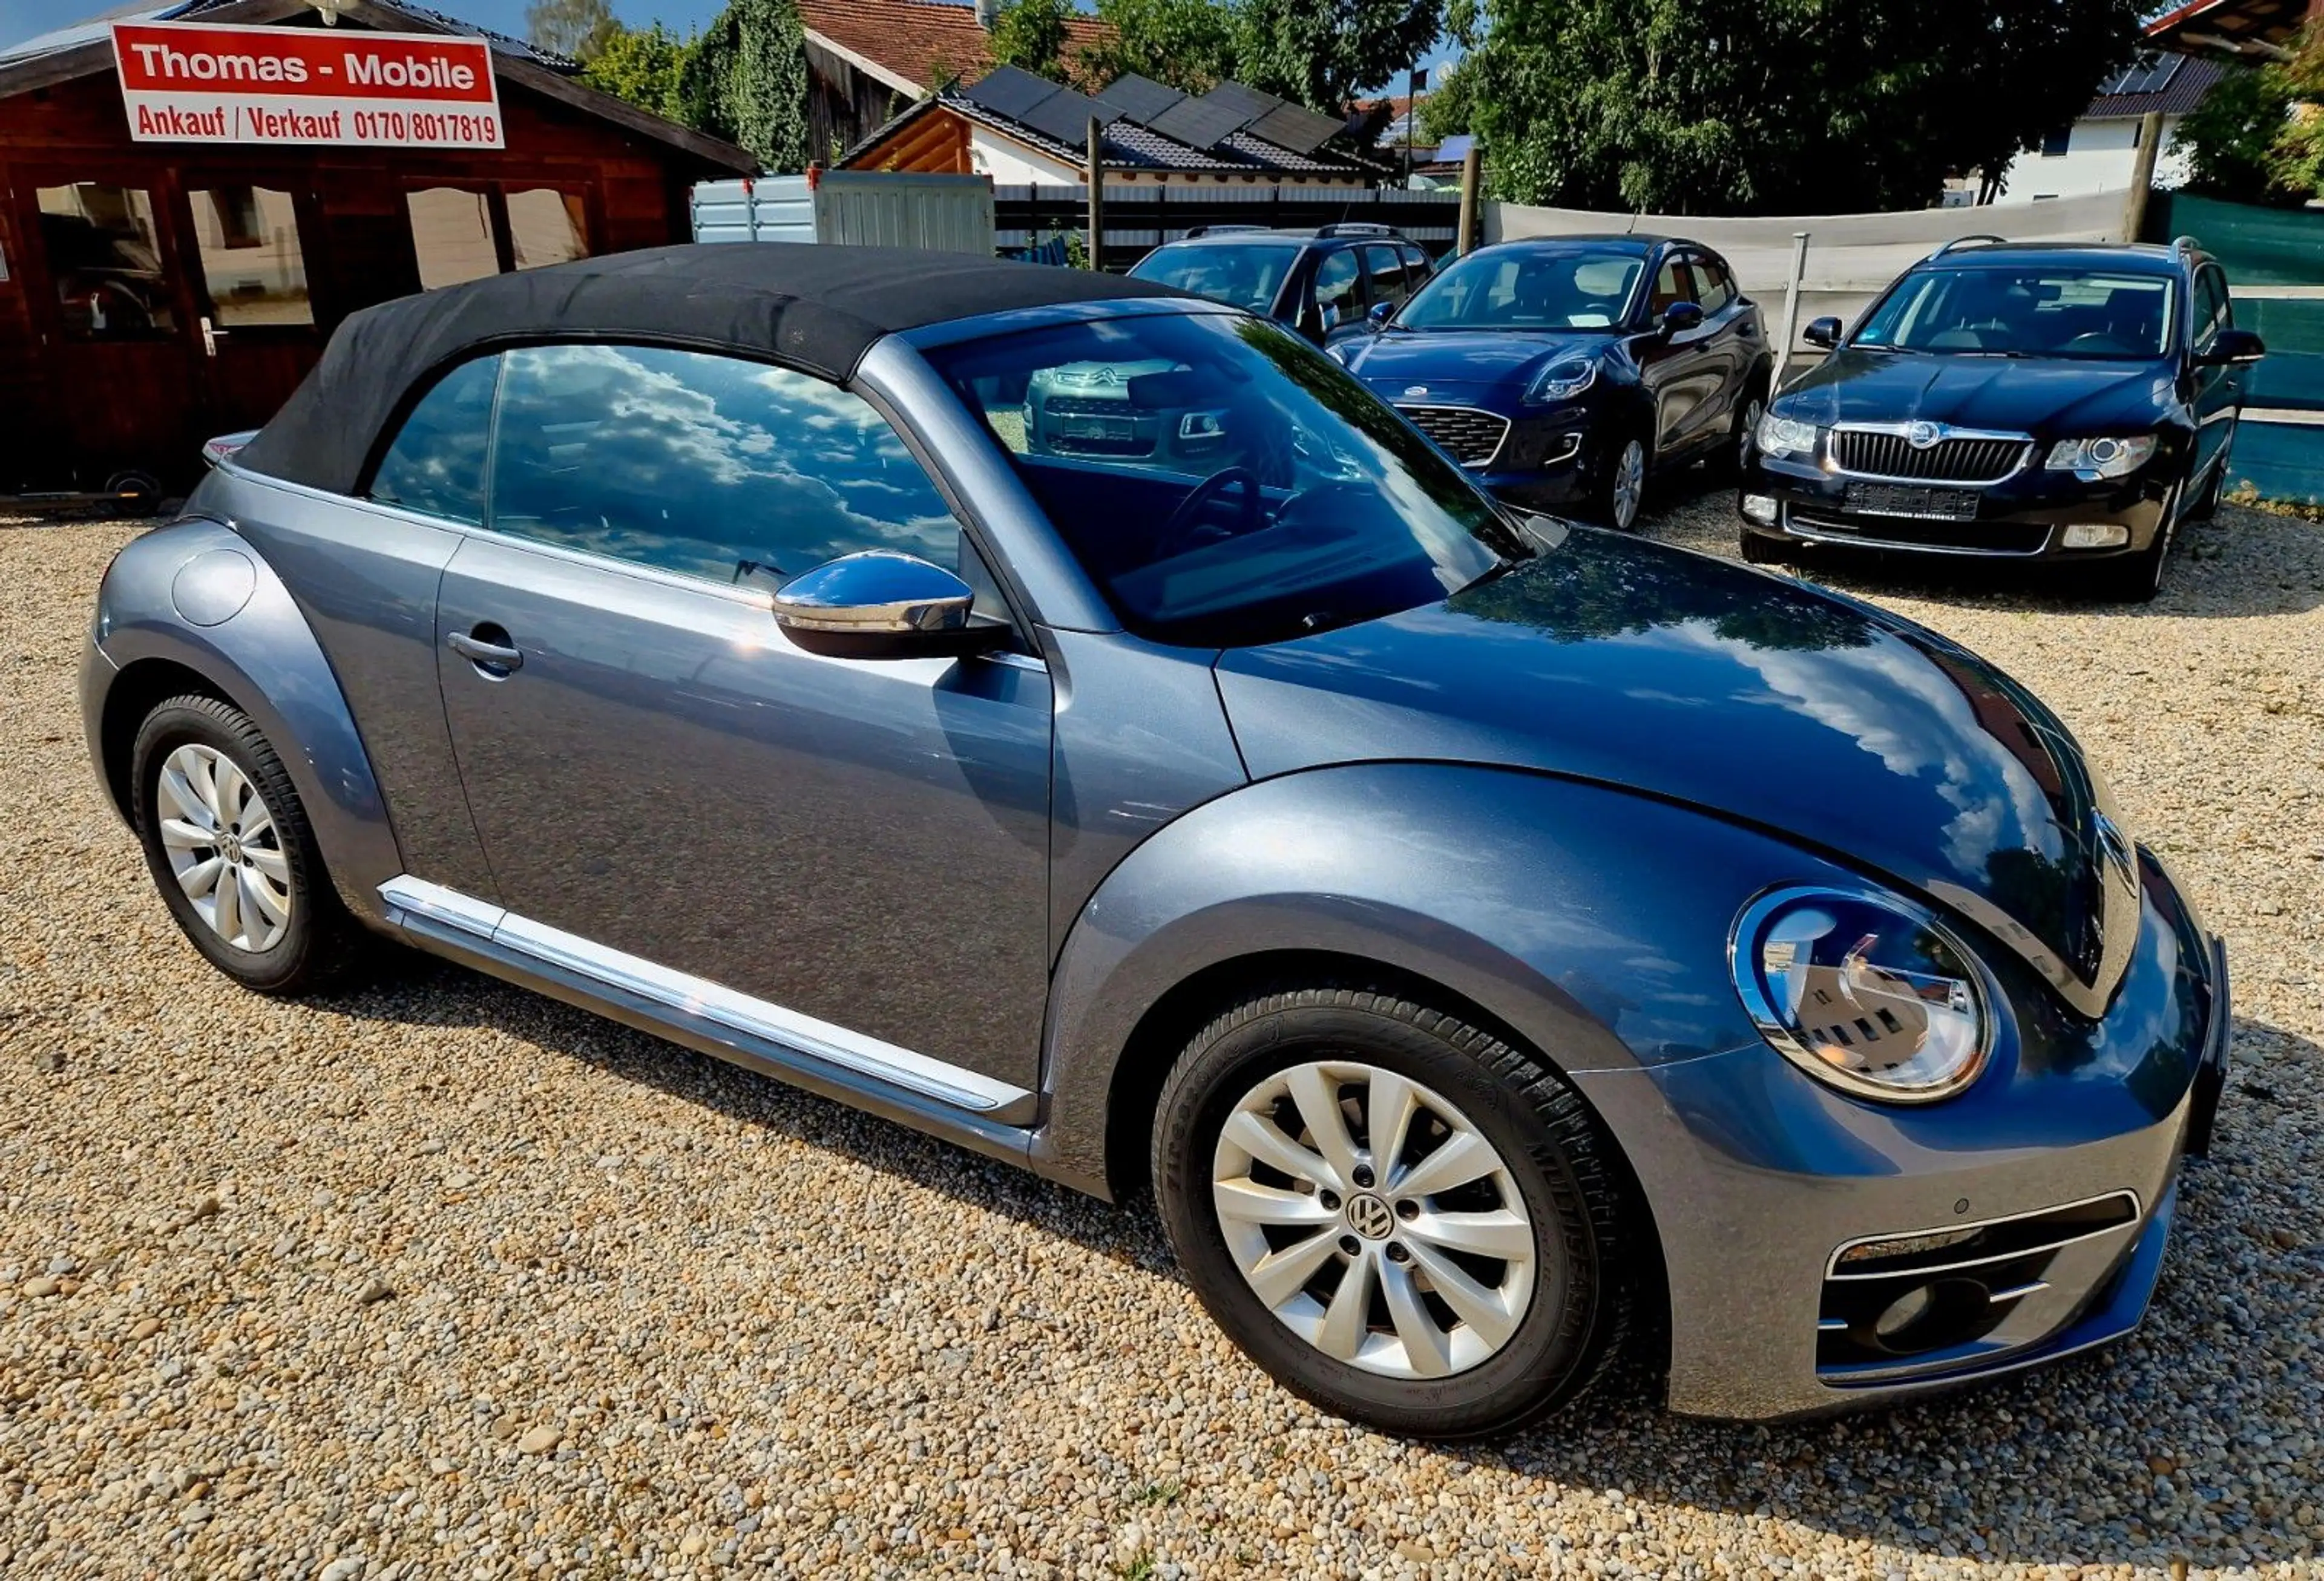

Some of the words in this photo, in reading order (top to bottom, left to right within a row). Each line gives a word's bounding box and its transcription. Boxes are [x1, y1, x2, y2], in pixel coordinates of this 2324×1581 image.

[131, 43, 309, 83] Thomas
[318, 66, 333, 74] -
[343, 53, 475, 90] Mobile
[137, 104, 226, 136] Ankauf
[247, 106, 342, 139] Verkauf
[353, 111, 496, 143] 0170/8017819
